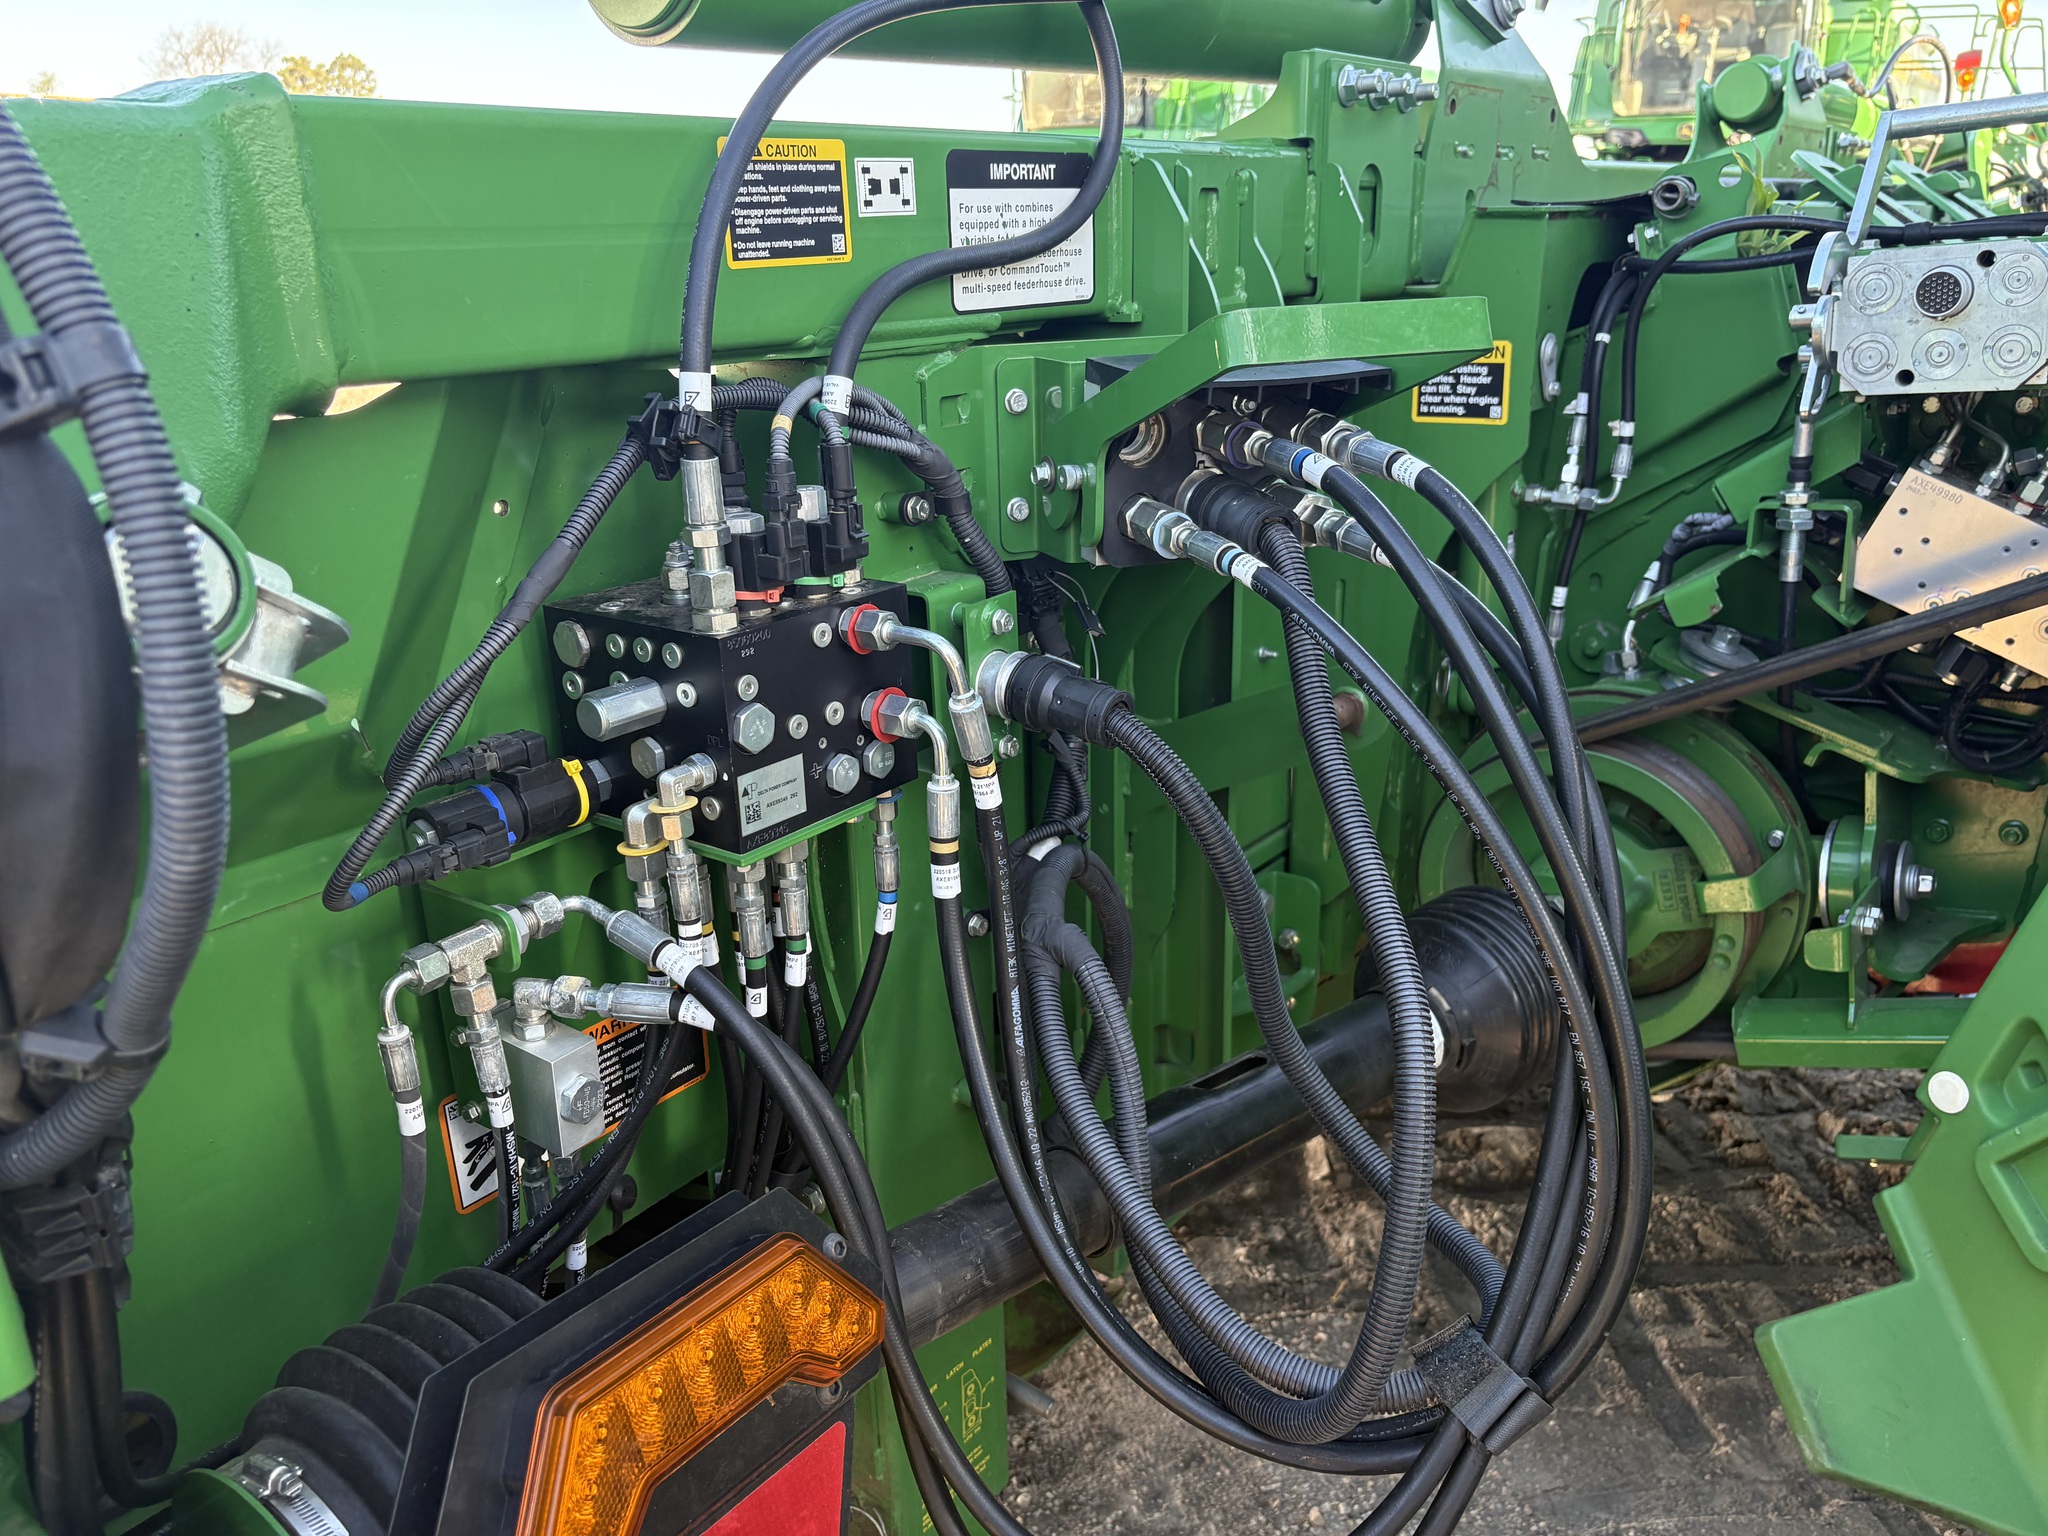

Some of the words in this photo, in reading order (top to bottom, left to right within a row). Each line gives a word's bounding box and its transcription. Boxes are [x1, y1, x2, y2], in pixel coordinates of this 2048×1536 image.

[766, 144, 816, 157] CAUTION
[755, 163, 775, 171] shields
[782, 163, 797, 172] place
[798, 163, 816, 172] during
[817, 163, 835, 171] normal
[990, 163, 1056, 180] IMPORTANT
[744, 172, 763, 180] ations.
[748, 185, 768, 194] hands,
[792, 184, 813, 194] clothing
[814, 185, 828, 194] away
[828, 184, 841, 192] from
[771, 195, 788, 204] parts.
[734, 207, 764, 217] Disengage
[765, 207, 800, 216] power-driven
[801, 206, 815, 215] parts
[959, 203, 974, 214] For
[977, 204, 992, 213] use
[995, 203, 1012, 213] with
[1015, 202, 1054, 212] combines
[735, 217, 744, 225] off
[744, 217, 763, 226] engine
[764, 216, 782, 224] before
[783, 215, 812, 225] unclogging
[819, 215, 843, 224] servicing
[960, 219, 999, 232] equipped
[1022, 220, 1027, 228] a
[735, 226, 762, 235] machine.
[737, 241, 746, 249] Do
[757, 240, 771, 248] leave
[772, 239, 793, 249] running
[793, 238, 815, 247] machine
[738, 249, 771, 258] unattended.
[988, 268, 997, 276] or
[962, 281, 1012, 295] multi-speed
[1014, 278, 1062, 291] feederhouse
[1065, 276, 1086, 287] drive.
[1460, 375, 1493, 385] Header
[1438, 385, 1453, 393] tilt.
[1456, 385, 1478, 396] Stay
[1420, 394, 1442, 403] clear
[1443, 396, 1467, 404] when
[1468, 396, 1500, 407] engine
[1420, 405, 1429, 413] is
[1429, 405, 1467, 416] running.
[1288, 612, 1336, 659] ALFAGOMMA
[768, 783, 781, 792] POWER
[781, 778, 798, 788] COMPANY
[1459, 806, 1469, 819] 21
[1468, 821, 1482, 841] MPa
[1483, 845, 1503, 874] (3000
[1501, 876, 1519, 900] PSI)
[1516, 905, 1541, 946] exceeds
[1539, 950, 1553, 969] SAE
[1549, 974, 1562, 992] 100
[807, 981, 819, 1003] MSHA
[1557, 996, 1572, 1016] R17
[1012, 985, 1025, 1048] ALFAGOMMA
[602, 1042, 616, 1051] from
[618, 1030, 638, 1043] contact
[1568, 1031, 1580, 1046] EN
[1573, 1050, 1587, 1070] 857
[611, 1077, 622, 1088] and
[1579, 1074, 1592, 1093] 1SC
[606, 1092, 626, 1106] remove
[1585, 1109, 1596, 1124] DN
[608, 1129, 620, 1145] EN
[1587, 1128, 1597, 1141] 10
[506, 1132, 518, 1165] MSHA
[1588, 1156, 1598, 1182] MSHA
[539, 1203, 553, 1218] DN
[483, 1241, 511, 1266] MSHA
[972, 1337, 993, 1358] PLATES
[945, 1361, 965, 1380] LATCH
